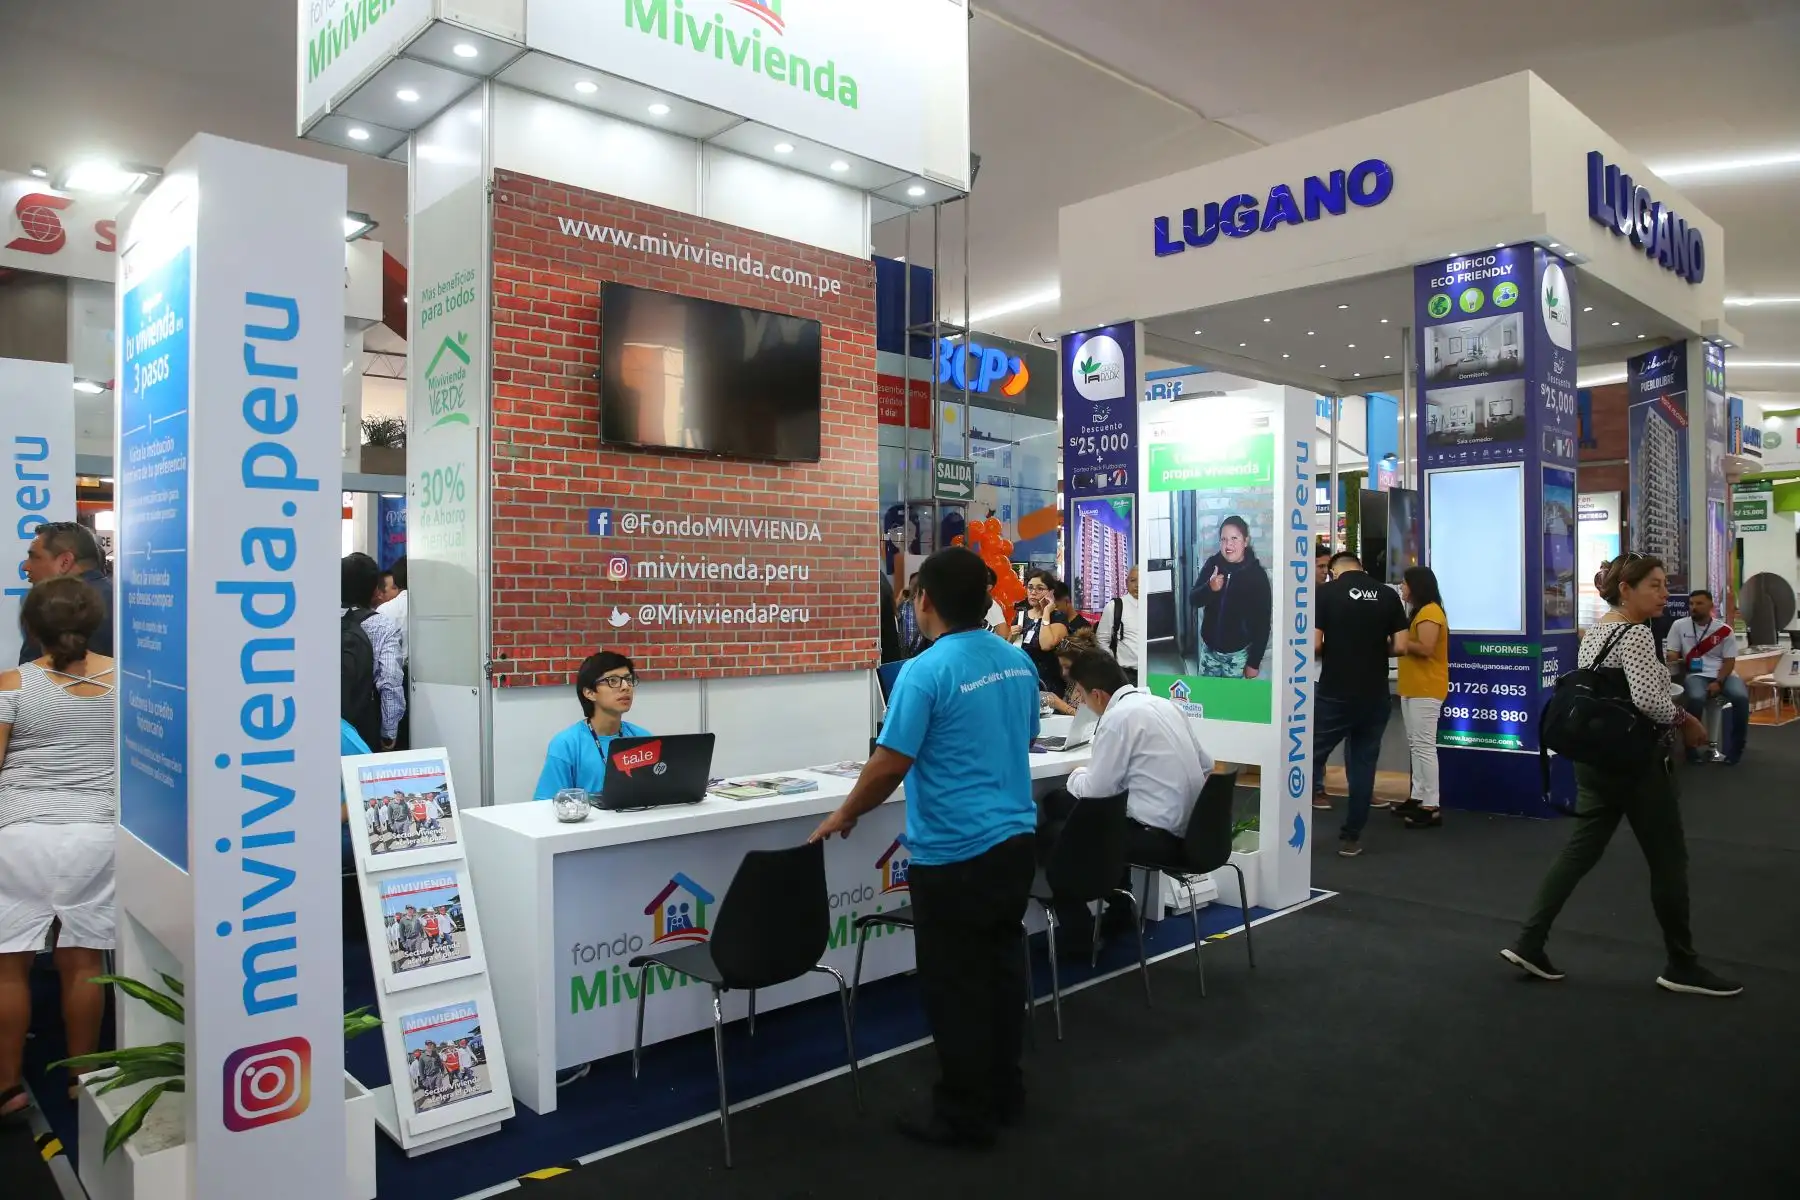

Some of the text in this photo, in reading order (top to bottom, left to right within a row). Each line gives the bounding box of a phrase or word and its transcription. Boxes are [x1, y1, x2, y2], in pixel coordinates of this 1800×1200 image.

[625, 0, 858, 109] Mivivienda
[1154, 158, 1394, 257] LUGANO
[1587, 150, 1705, 284] LUGANO
[557, 216, 841, 298] www.mivivienda.com.pe
[1446, 255, 1496, 273] EDIFICIO
[437, 269, 475, 296] beneficios
[1431, 264, 1513, 289] ECO FRIENDLY
[421, 286, 475, 328] para todos
[136, 304, 175, 352] vivienda
[141, 353, 169, 400] pasos
[428, 367, 466, 391] Mivivienda
[429, 382, 466, 417] VERDE
[1081, 422, 1123, 434] Descuento
[937, 462, 972, 482] SALIDA
[421, 465, 465, 508] 30%
[621, 513, 822, 542] @FondoMIVIVIENDA
[637, 555, 809, 586] mivivienda.peru
[638, 602, 810, 626] @MiviviendaPeru
[1288, 441, 1309, 799] @MiviviendaPeru
[215, 291, 320, 1017] mivivienda.peru
[1480, 644, 1528, 654] INFORMES
[1448, 662, 1530, 671] ontacto@luganosac.com
[1464, 682, 1488, 694] 726
[1491, 683, 1527, 696] 4953
[1443, 706, 1528, 722] 998 288 980
[622, 750, 653, 766] tale
[387, 876, 454, 895] MIVIVIENDA
[829, 883, 874, 909] ondo
[571, 932, 643, 966] fondo
[406, 1007, 475, 1031] MIVIVIENDA
